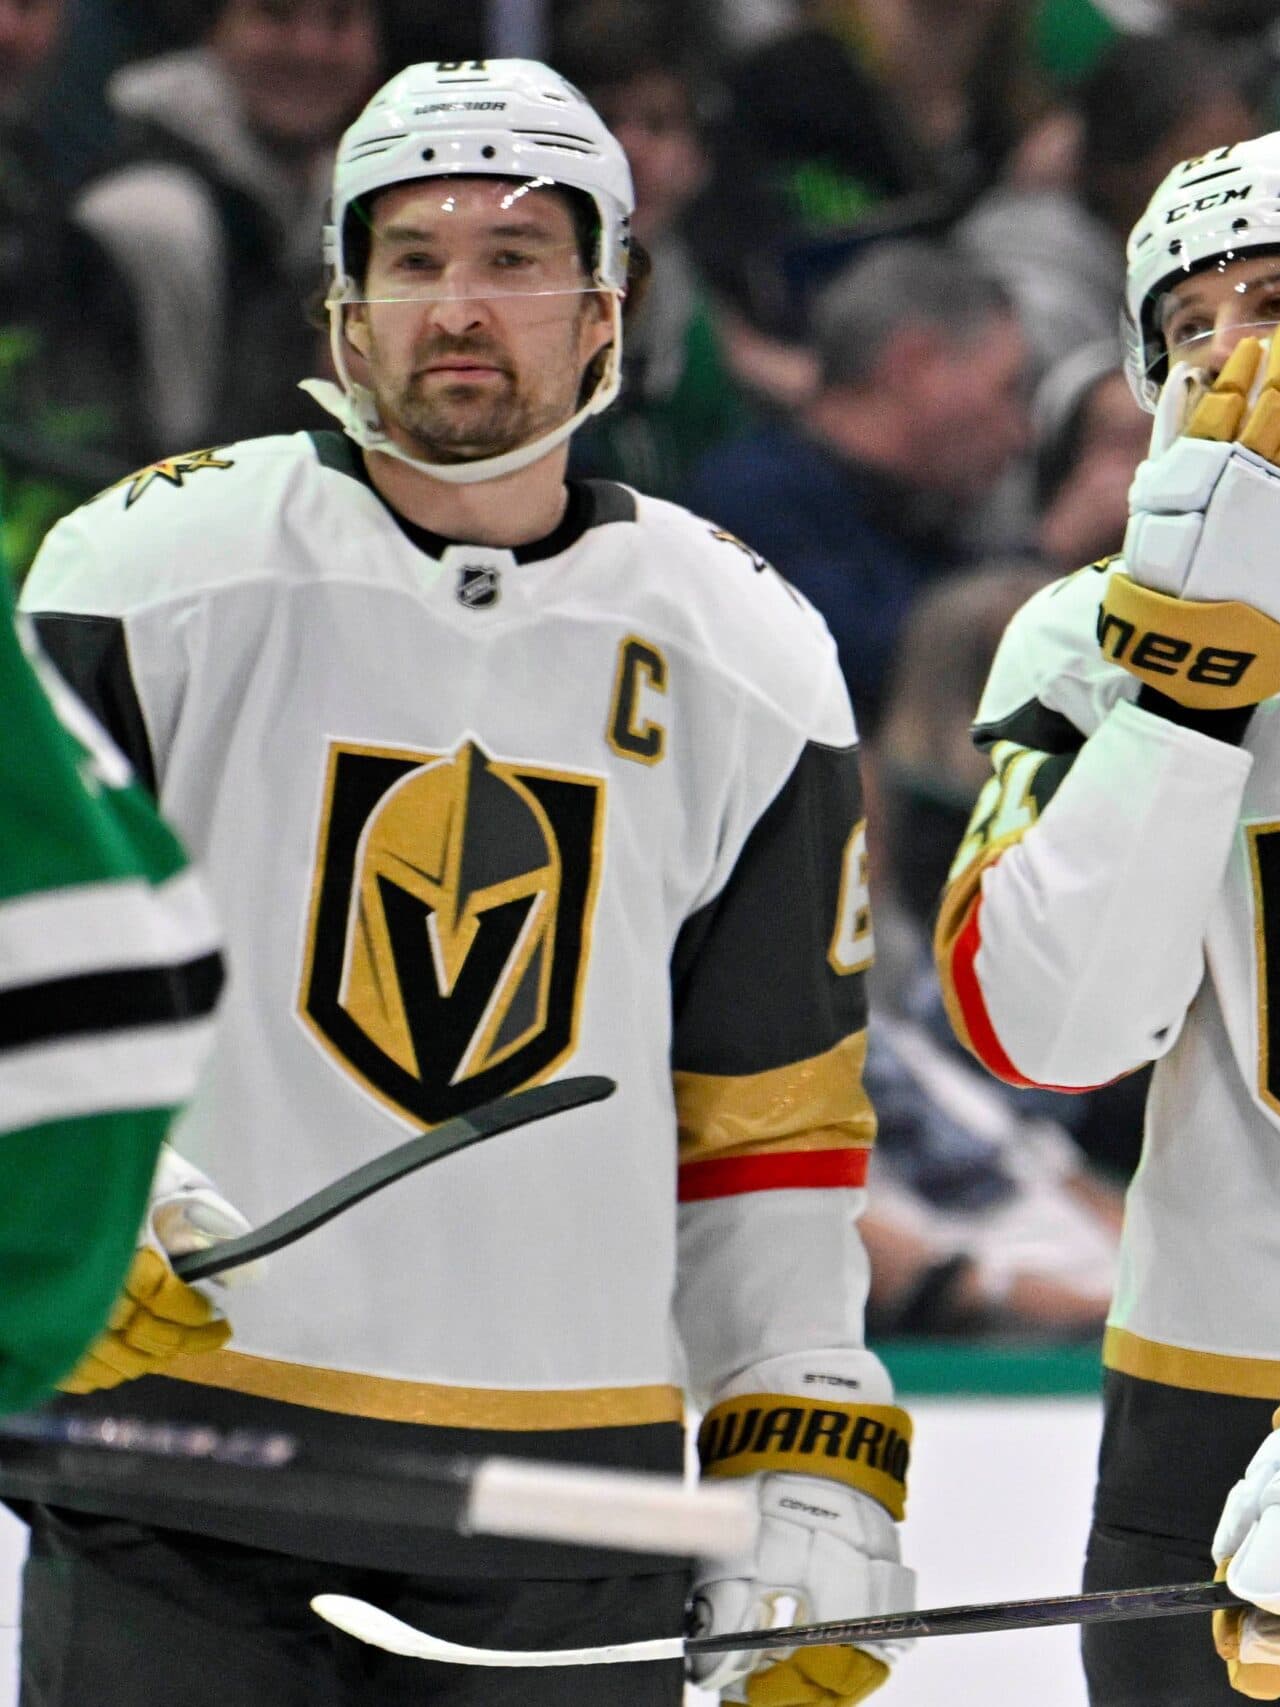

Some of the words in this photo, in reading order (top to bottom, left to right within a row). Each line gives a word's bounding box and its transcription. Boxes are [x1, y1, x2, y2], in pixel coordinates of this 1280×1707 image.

[1166, 184, 1252, 224] CCM
[605, 634, 668, 768] C
[802, 1373, 860, 1390] STONE
